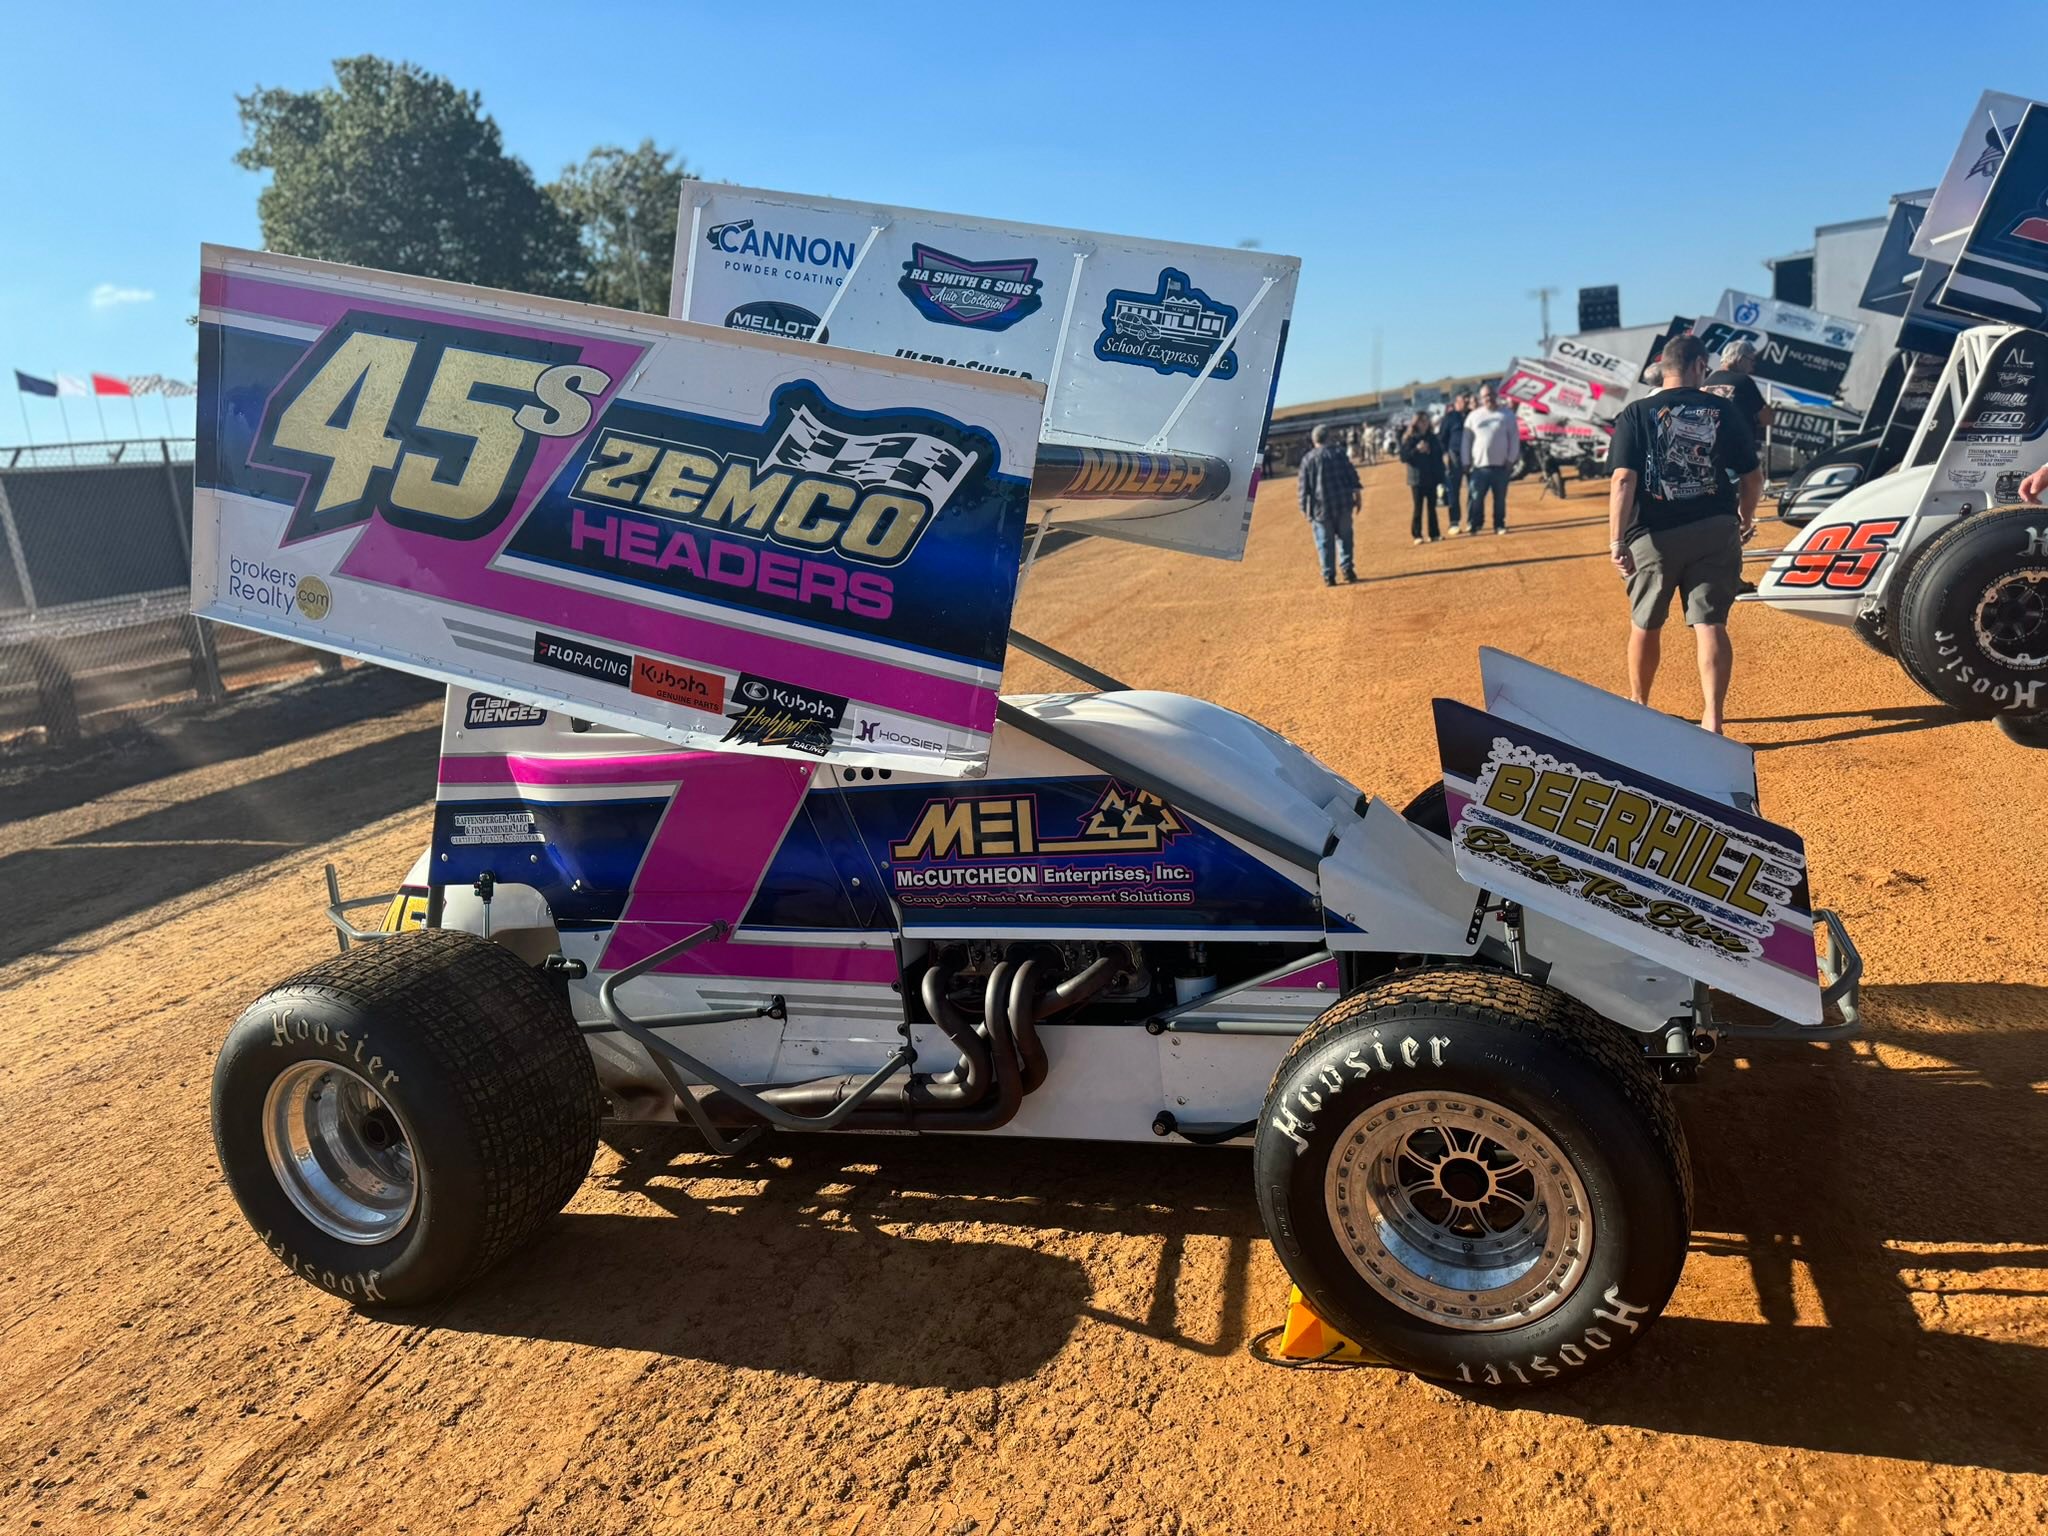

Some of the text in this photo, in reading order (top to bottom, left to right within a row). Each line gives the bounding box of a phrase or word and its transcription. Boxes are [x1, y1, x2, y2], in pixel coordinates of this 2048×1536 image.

[720, 225, 855, 270] CANNON
[724, 261, 844, 287] POWDER COATING
[910, 268, 1034, 297] RA SMITH & SONS
[930, 287, 1006, 312] Auto Collision
[1102, 337, 1150, 356] School
[1148, 345, 1200, 366] Express,
[1557, 342, 1621, 372] CASE
[1788, 350, 1847, 371] NUTREND
[1967, 435, 2013, 443] SMITH
[1069, 449, 1206, 493] MILLER
[577, 436, 927, 559] ZEMCO
[571, 510, 894, 620] HEADERS
[1780, 521, 1901, 588] 95
[229, 553, 297, 588] brokers
[229, 575, 295, 615] Realty
[547, 644, 629, 677] FLORACING
[1935, 630, 2047, 709] Hoosier
[640, 662, 709, 696] Kubota
[469, 706, 541, 723] MENGES
[656, 689, 720, 711] GENUINE PARTS
[772, 688, 835, 718] Kubota
[791, 740, 825, 754] RACING
[879, 729, 943, 752] HOOSIER
[465, 826, 471, 835] &
[1483, 763, 1769, 917] BEERHILL
[896, 865, 1190, 887] McCUTCHEON Enterprises, Inc.
[1463, 826, 1751, 953] Backs The Blue
[901, 890, 1191, 905] Complete Waste Management Solutions
[271, 1008, 399, 1090] Hoosier
[1272, 1028, 1452, 1156] Hoosier
[1456, 1282, 1650, 1386] Hoosier
